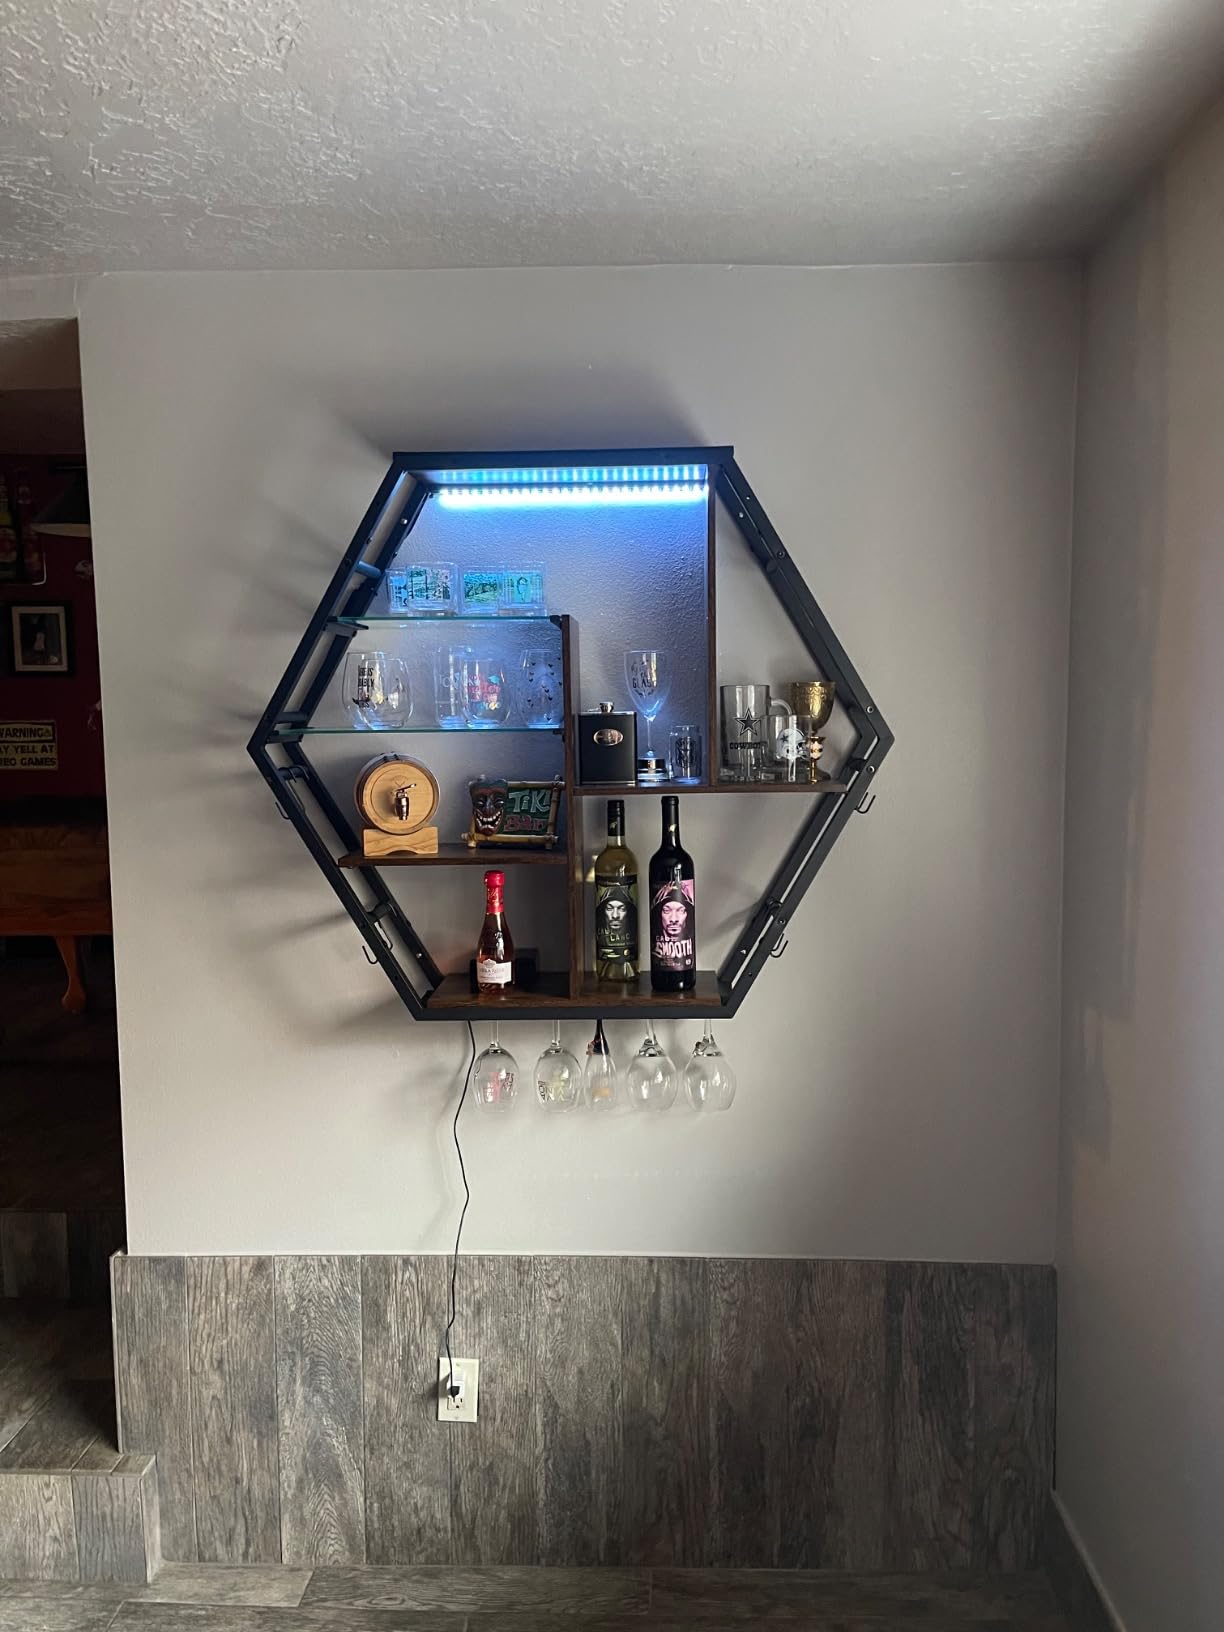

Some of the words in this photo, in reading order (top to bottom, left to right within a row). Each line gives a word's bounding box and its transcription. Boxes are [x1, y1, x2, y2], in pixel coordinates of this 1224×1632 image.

[632, 677, 657, 689] GLAS
[12, 745, 38, 753] YELL
[41, 745, 54, 753] AT
[20, 757, 57, 766] GAMES
[655, 938, 693, 959] SMOOTH
